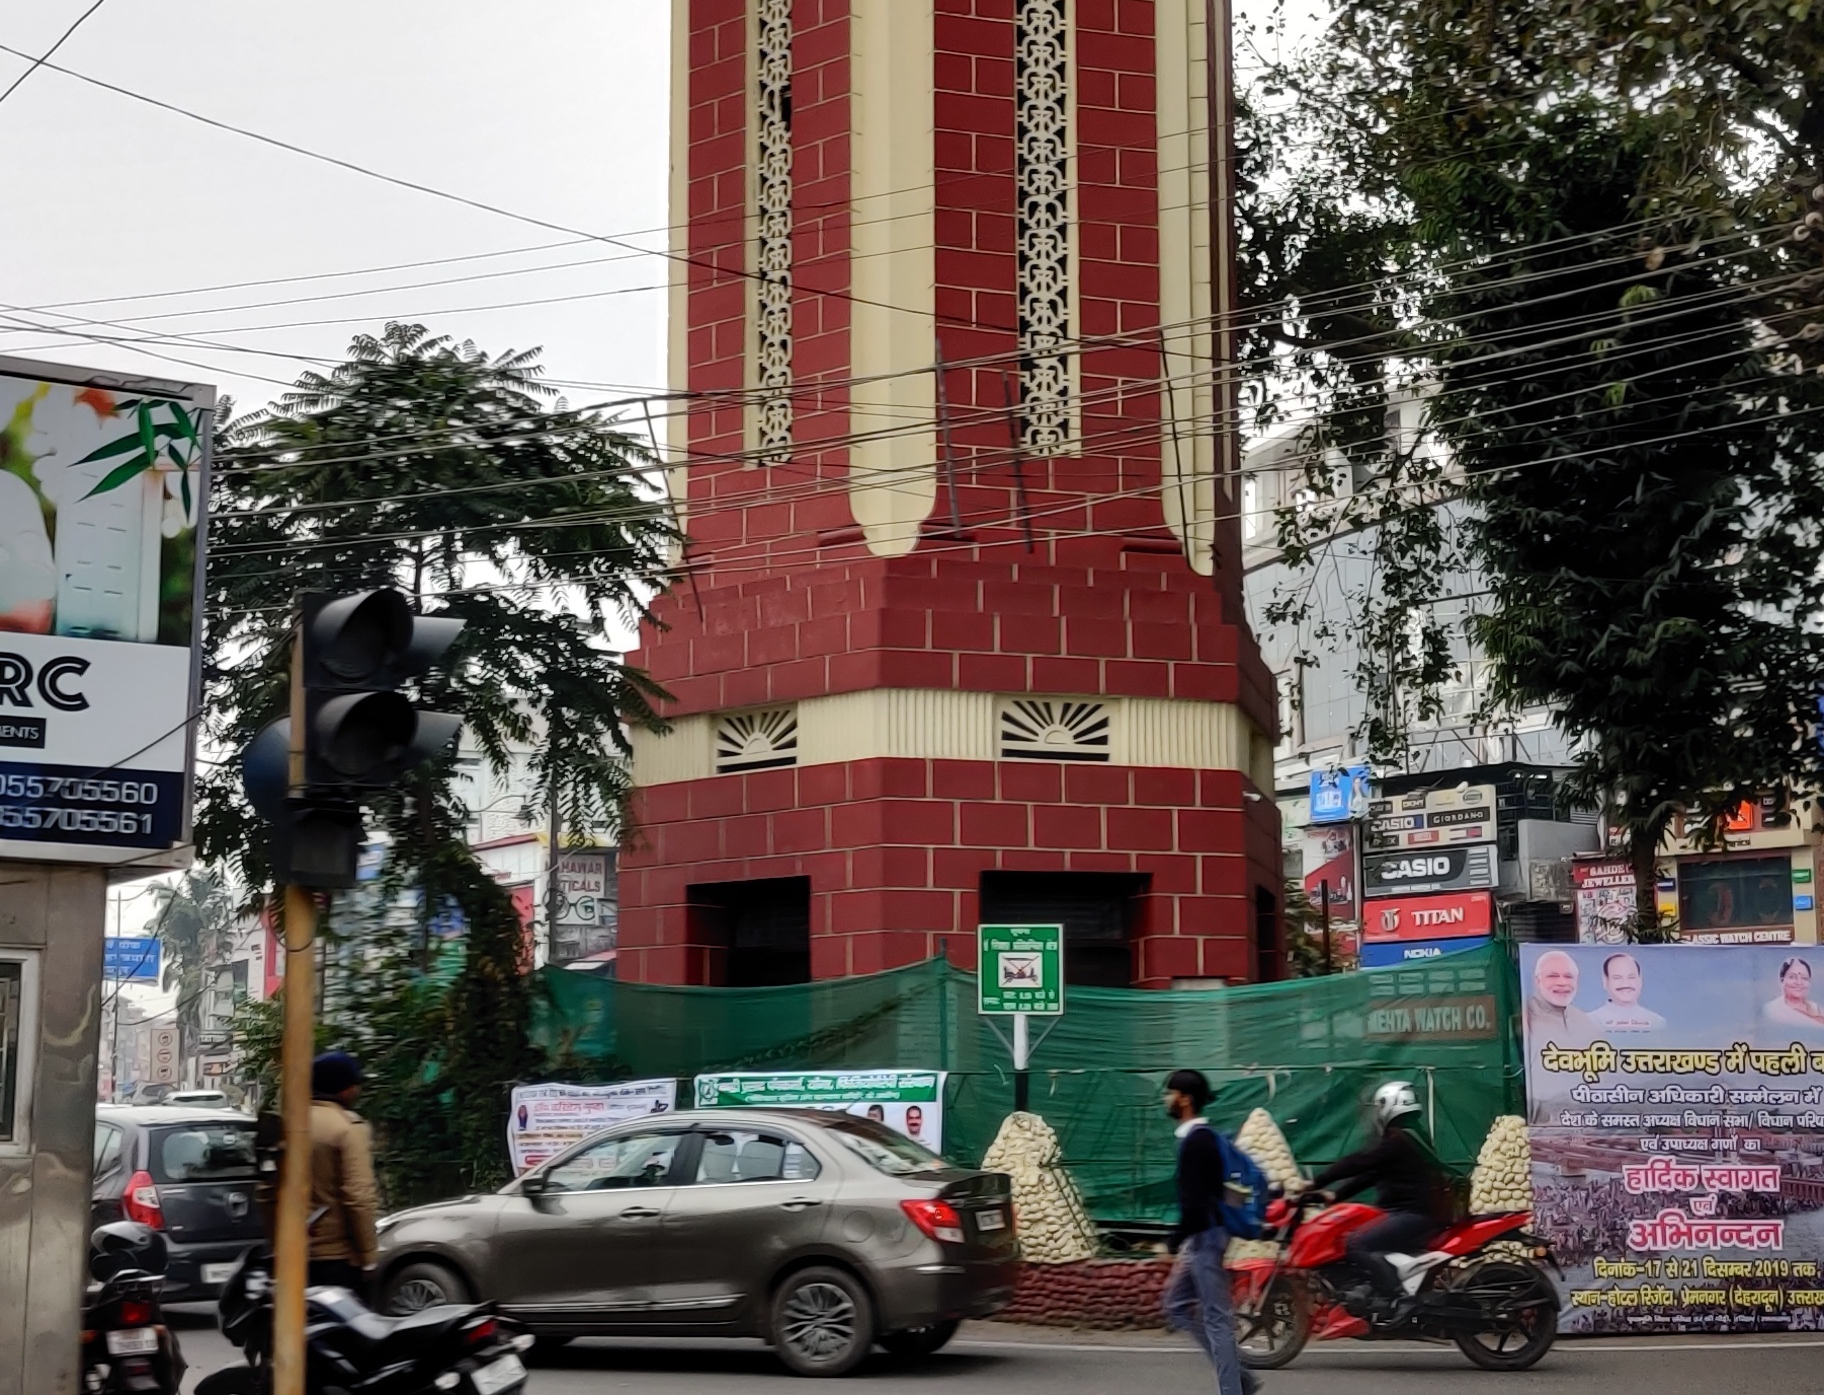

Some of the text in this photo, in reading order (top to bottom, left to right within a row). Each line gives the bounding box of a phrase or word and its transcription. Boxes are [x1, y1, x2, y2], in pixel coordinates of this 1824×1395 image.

[0, 725, 40, 740] ENTS
[1381, 856, 1450, 879] CASIO
[1411, 907, 1464, 926] TITAN
[1720, 932, 1752, 944] WATCH
[1754, 930, 1792, 942] CENTRE
[1403, 948, 1442, 959] NOKIA
[1414, 1005, 1461, 1032] WATCH
[1465, 1004, 1491, 1030] CO.
[1541, 1040, 1618, 1083] देवभूमि
[1620, 1049, 1722, 1076] उत्तराखण्ड
[1724, 1042, 1749, 1074] में
[1750, 1041, 1808, 1076] पहली
[1647, 1084, 1726, 1104] अधिकारी
[1728, 1085, 1800, 1104] सम्मेलन
[1802, 1085, 1823, 1104] में
[1583, 1110, 1599, 1127] के
[1601, 1114, 1640, 1128] समस्त
[1683, 1109, 1720, 1127] विधान
[1757, 1110, 1794, 1128] विधान
[1743, 1137, 1761, 1151] का
[1623, 1156, 1780, 1193] हार्दिक स्वागत
[1690, 1194, 1718, 1216] एवं
[1628, 1208, 1783, 1250] अभिनन्दन
[1665, 1256, 1679, 1278] से
[1681, 1258, 1698, 1278] 21
[1754, 1258, 1789, 1277] 2019
[1680, 1284, 1726, 1308] प्रेमनगर
